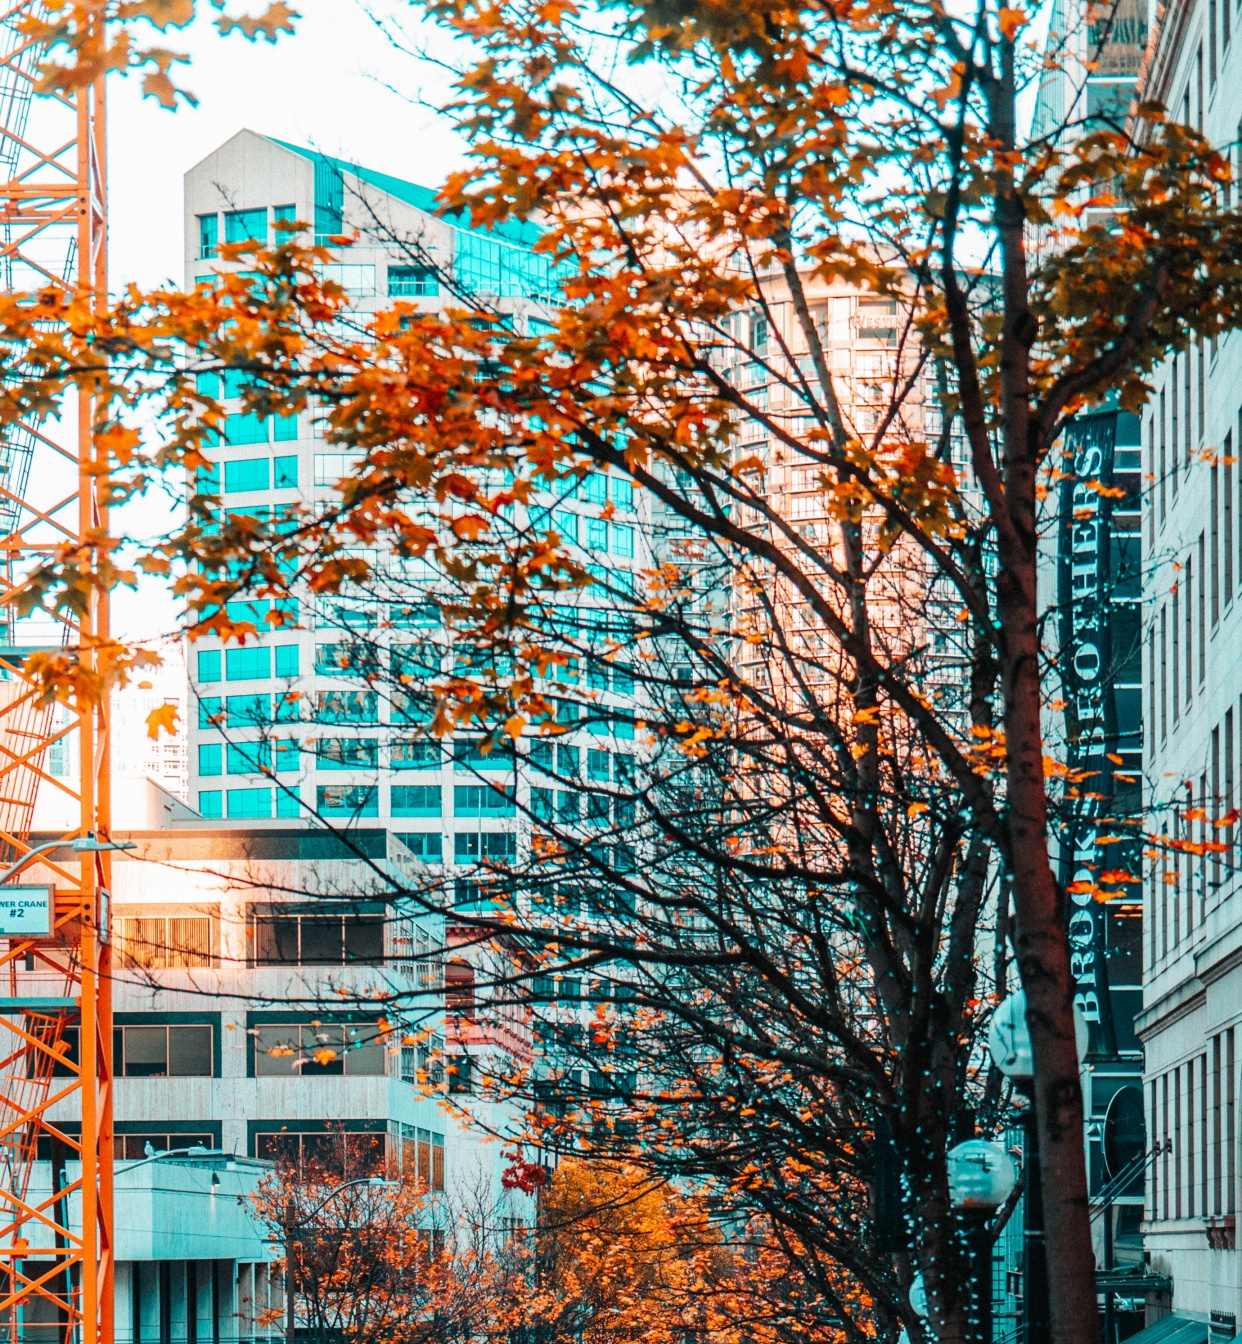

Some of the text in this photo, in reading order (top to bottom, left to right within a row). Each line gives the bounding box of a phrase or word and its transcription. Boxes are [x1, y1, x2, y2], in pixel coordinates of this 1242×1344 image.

[1072, 446, 1105, 760] BROTHERS
[0, 900, 48, 908] WER CRANE
[9, 908, 25, 918] #2
